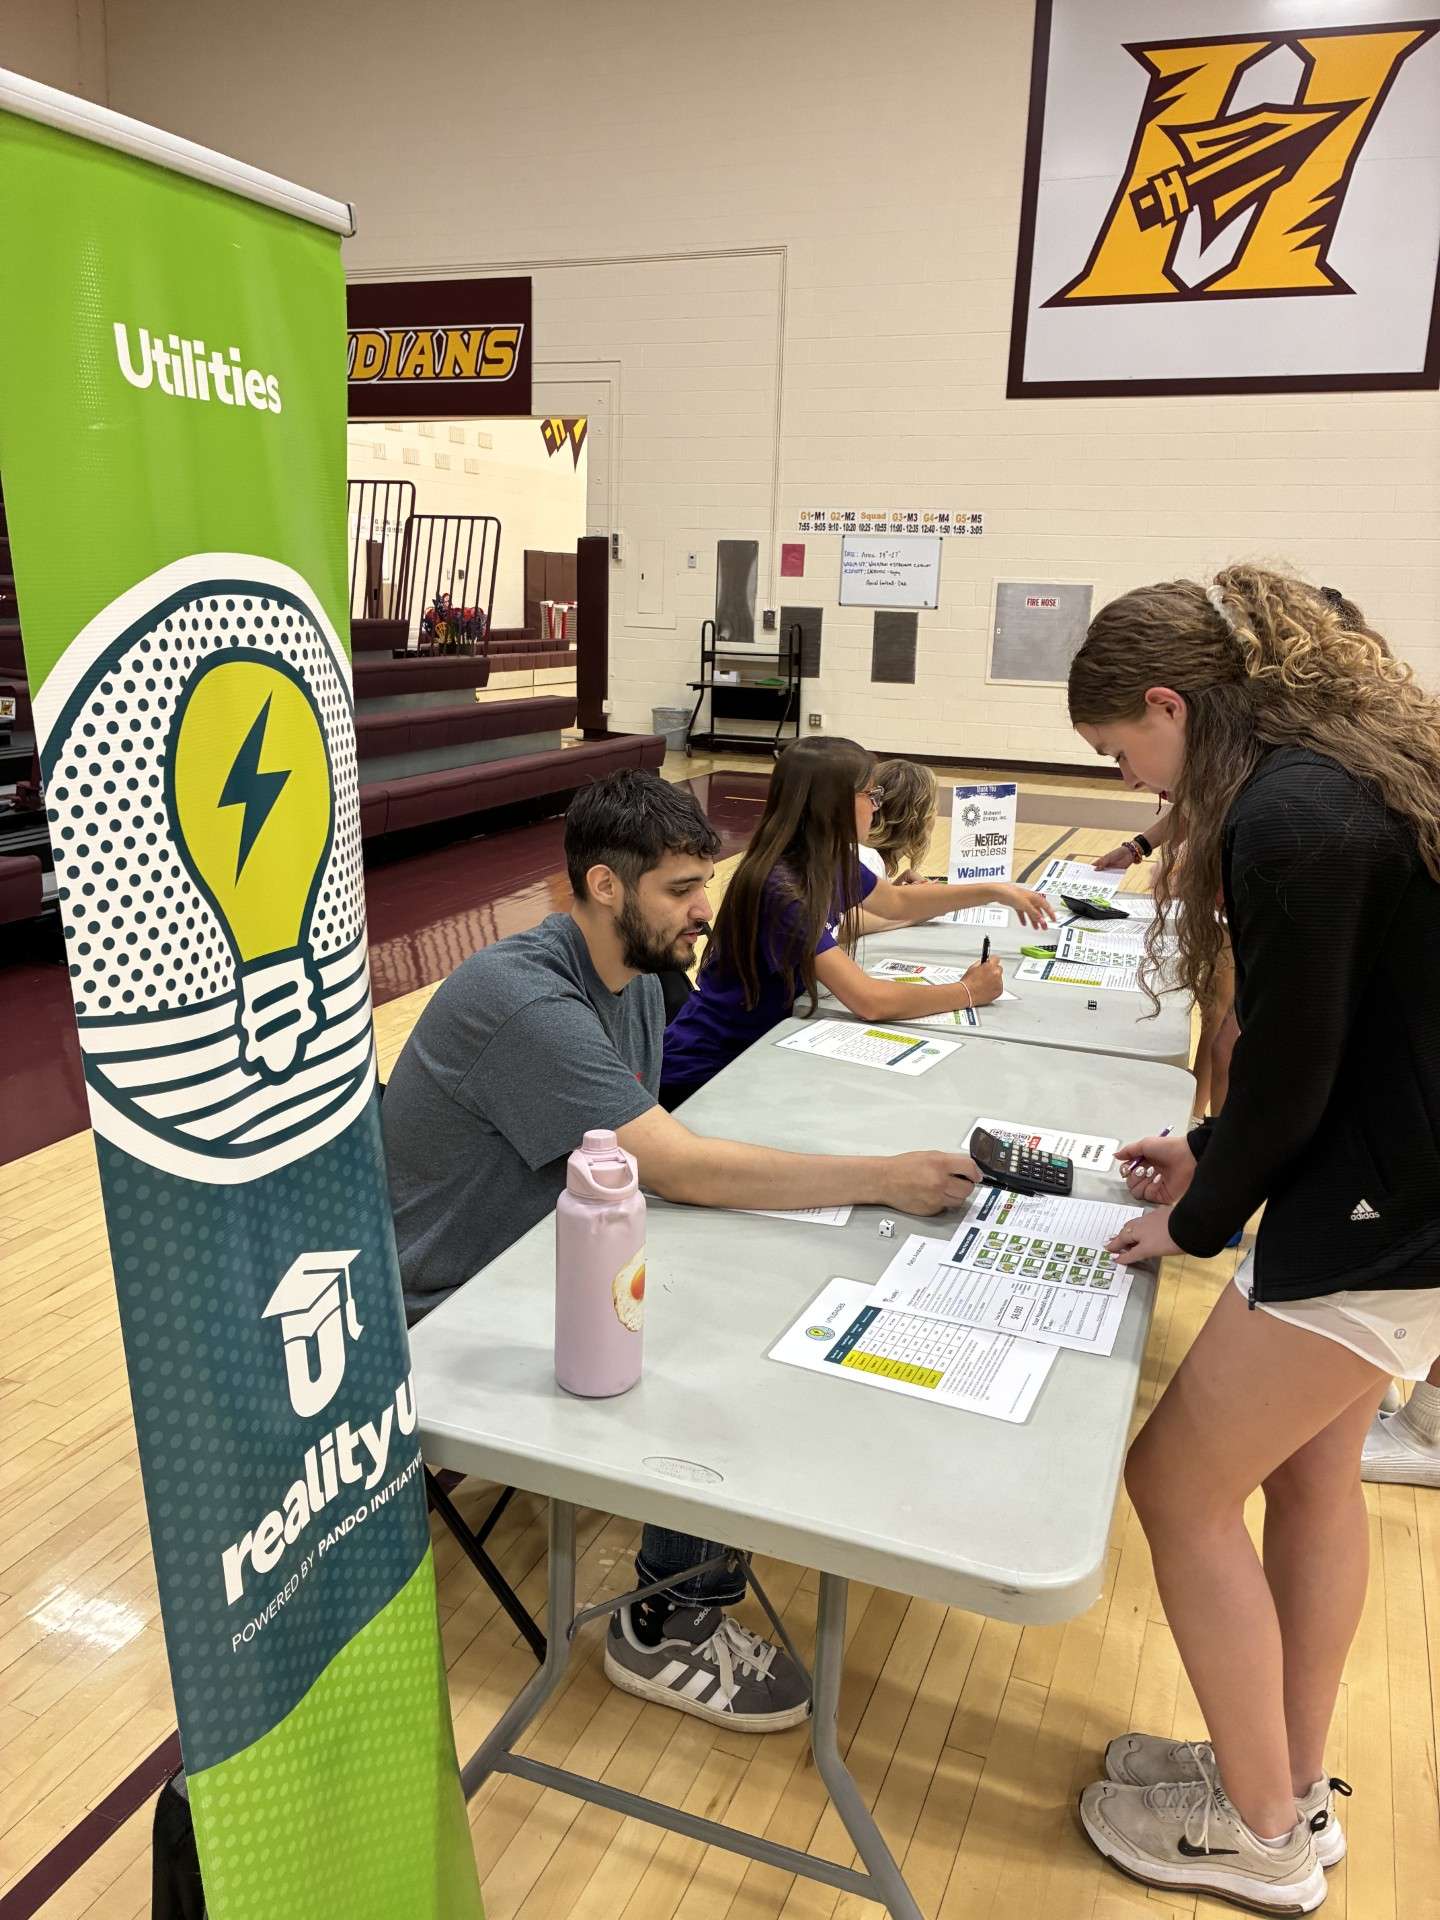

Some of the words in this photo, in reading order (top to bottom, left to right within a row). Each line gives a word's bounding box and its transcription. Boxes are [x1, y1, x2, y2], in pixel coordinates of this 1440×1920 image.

[1039, 19, 1440, 308] H
[347, 325, 524, 383] DIANS
[113, 322, 282, 414] Utilities
[861, 511, 887, 522] Squad
[1026, 598, 1039, 607] FIRE
[1041, 598, 1057, 607] HOSE
[961, 846, 1007, 858] wireless
[957, 864, 1006, 879] Walmart
[1350, 1210, 1381, 1221] adidas
[232, 1574, 299, 1653] POWERED
[300, 1552, 314, 1580] BY
[318, 1505, 368, 1558] PANDO
